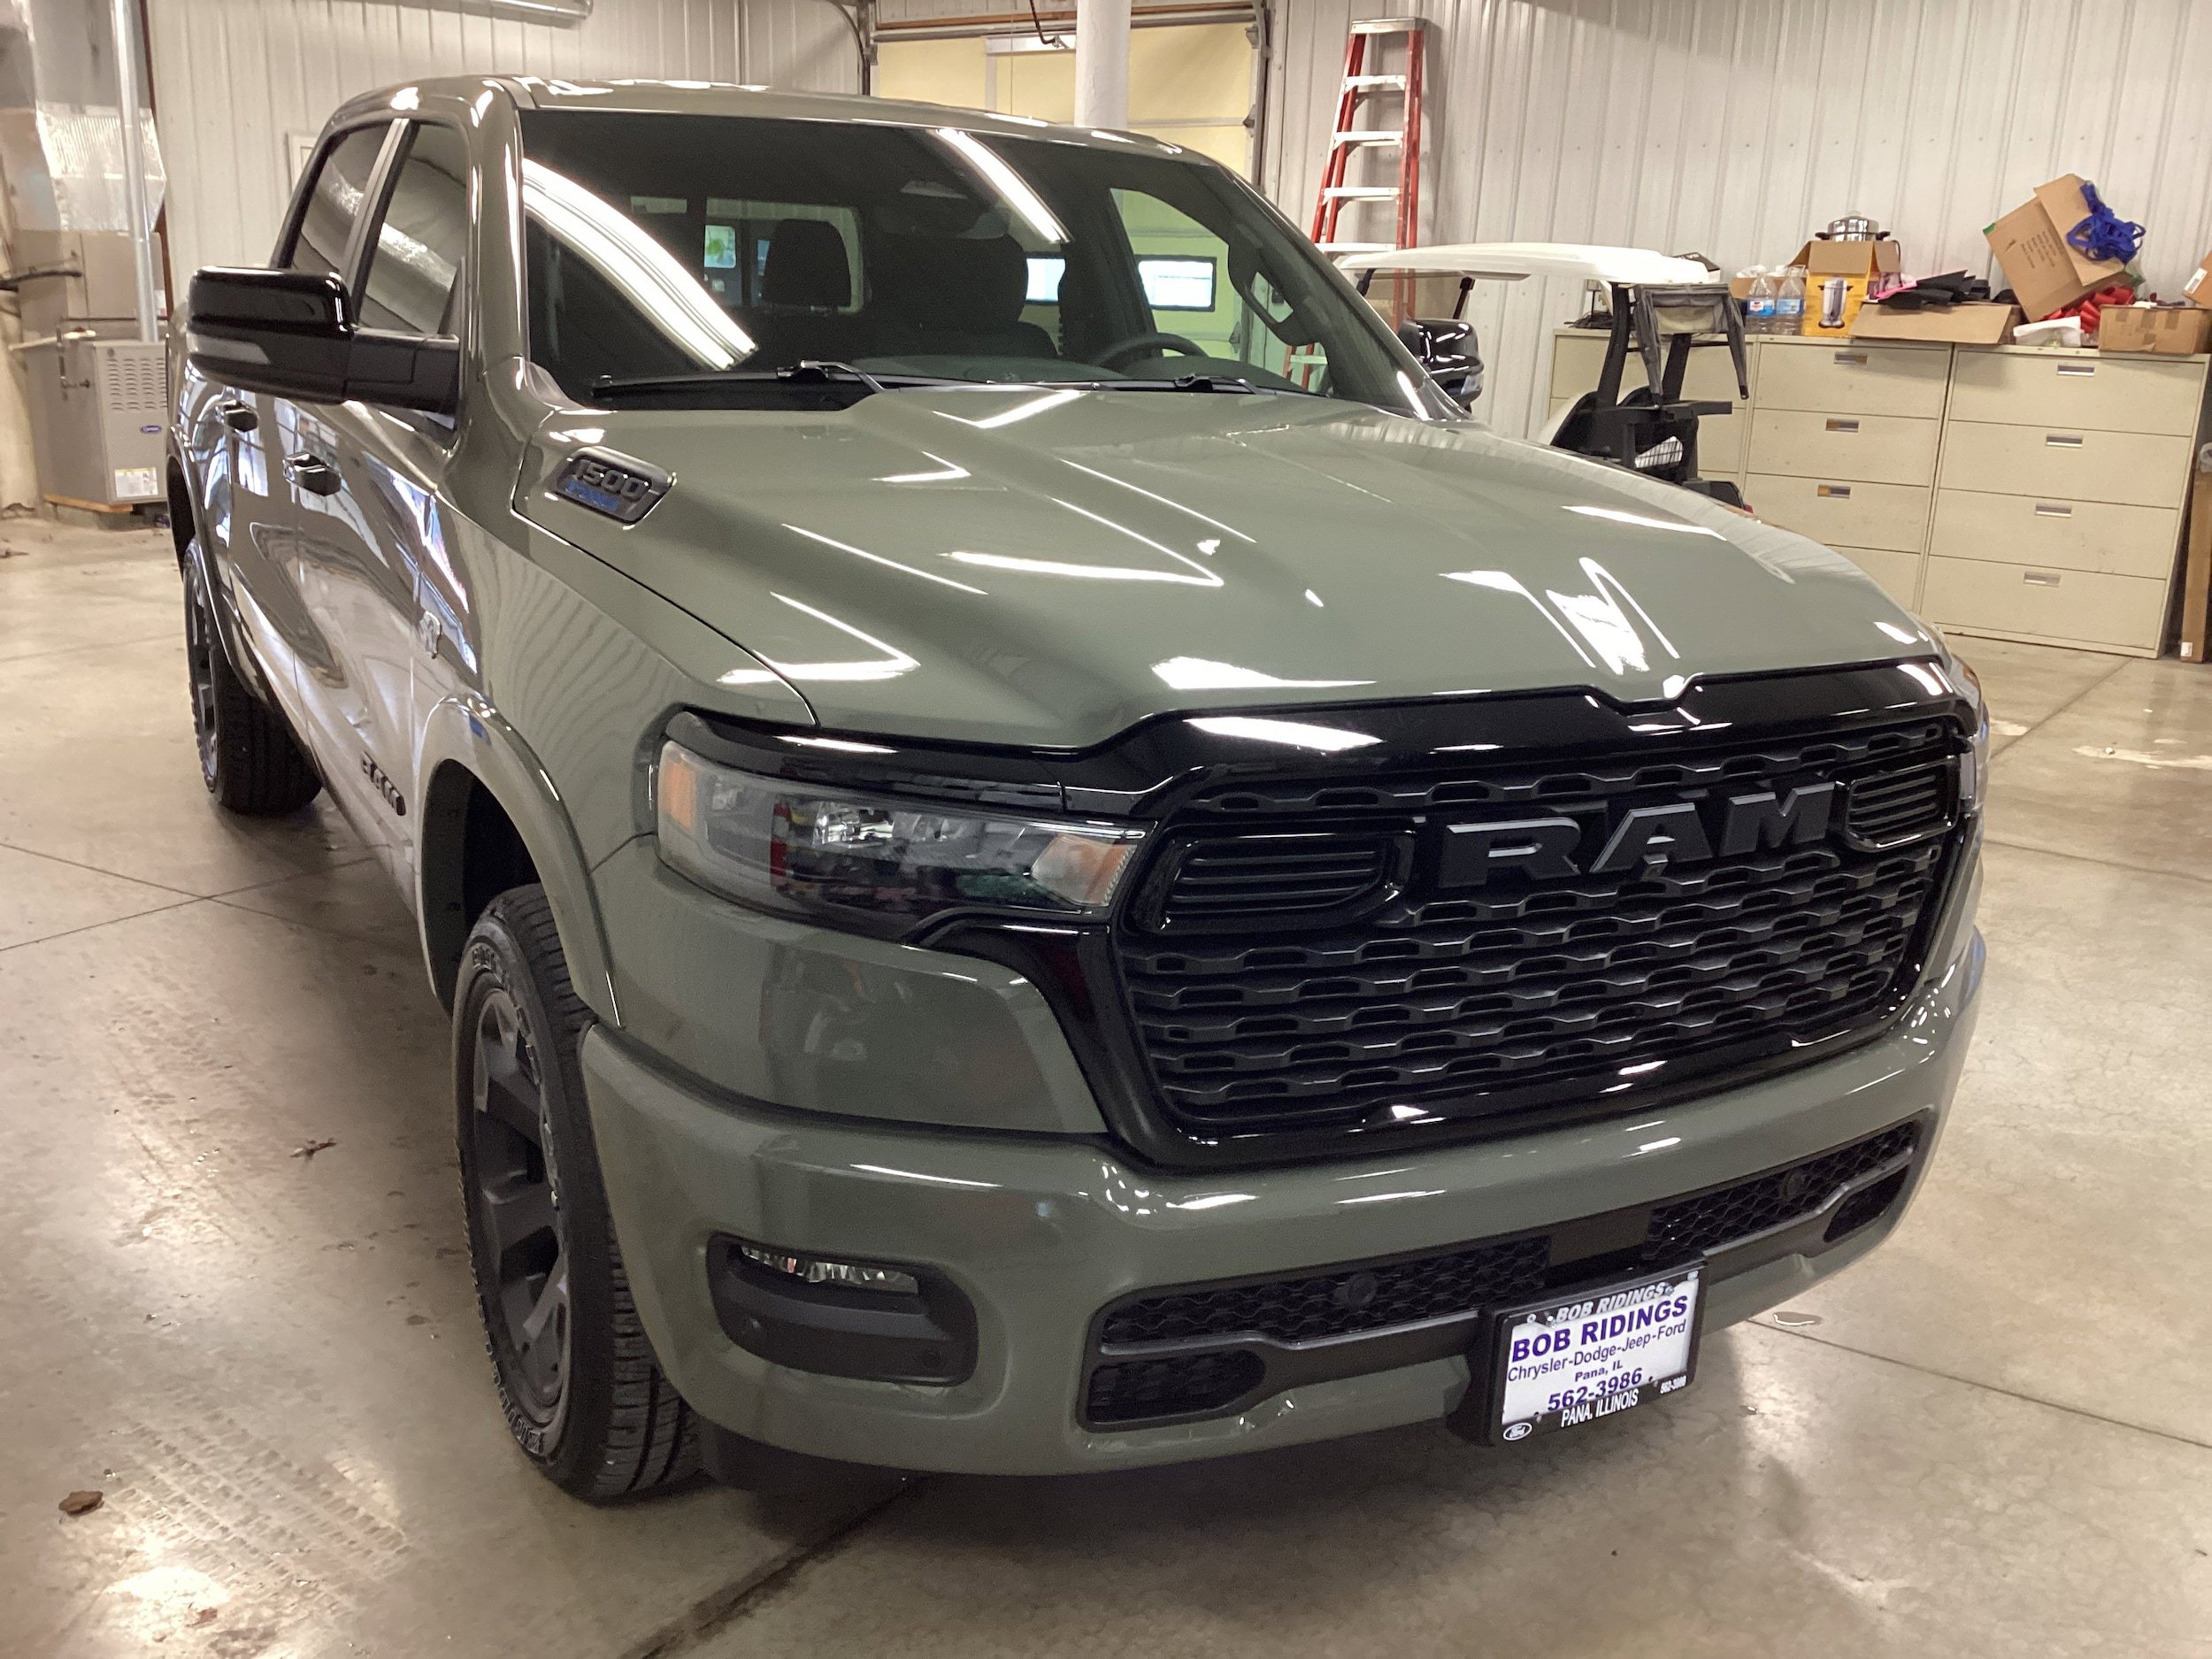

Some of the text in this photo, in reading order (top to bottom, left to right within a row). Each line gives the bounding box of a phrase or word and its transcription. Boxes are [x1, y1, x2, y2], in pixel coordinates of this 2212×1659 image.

[1439, 781, 1836, 888] RAM
[1555, 1282, 1666, 1323] BOB RIDINGS
[1508, 1319, 1686, 1382] Chrysler-Dodge-Jeep-Ford
[1511, 1295, 1688, 1363] BOB RIDINGS
[1548, 1367, 1643, 1411] 562-3986
[1574, 1360, 1624, 1382] Pana, IL
[1595, 1387, 1640, 1417] ILLINOIS
